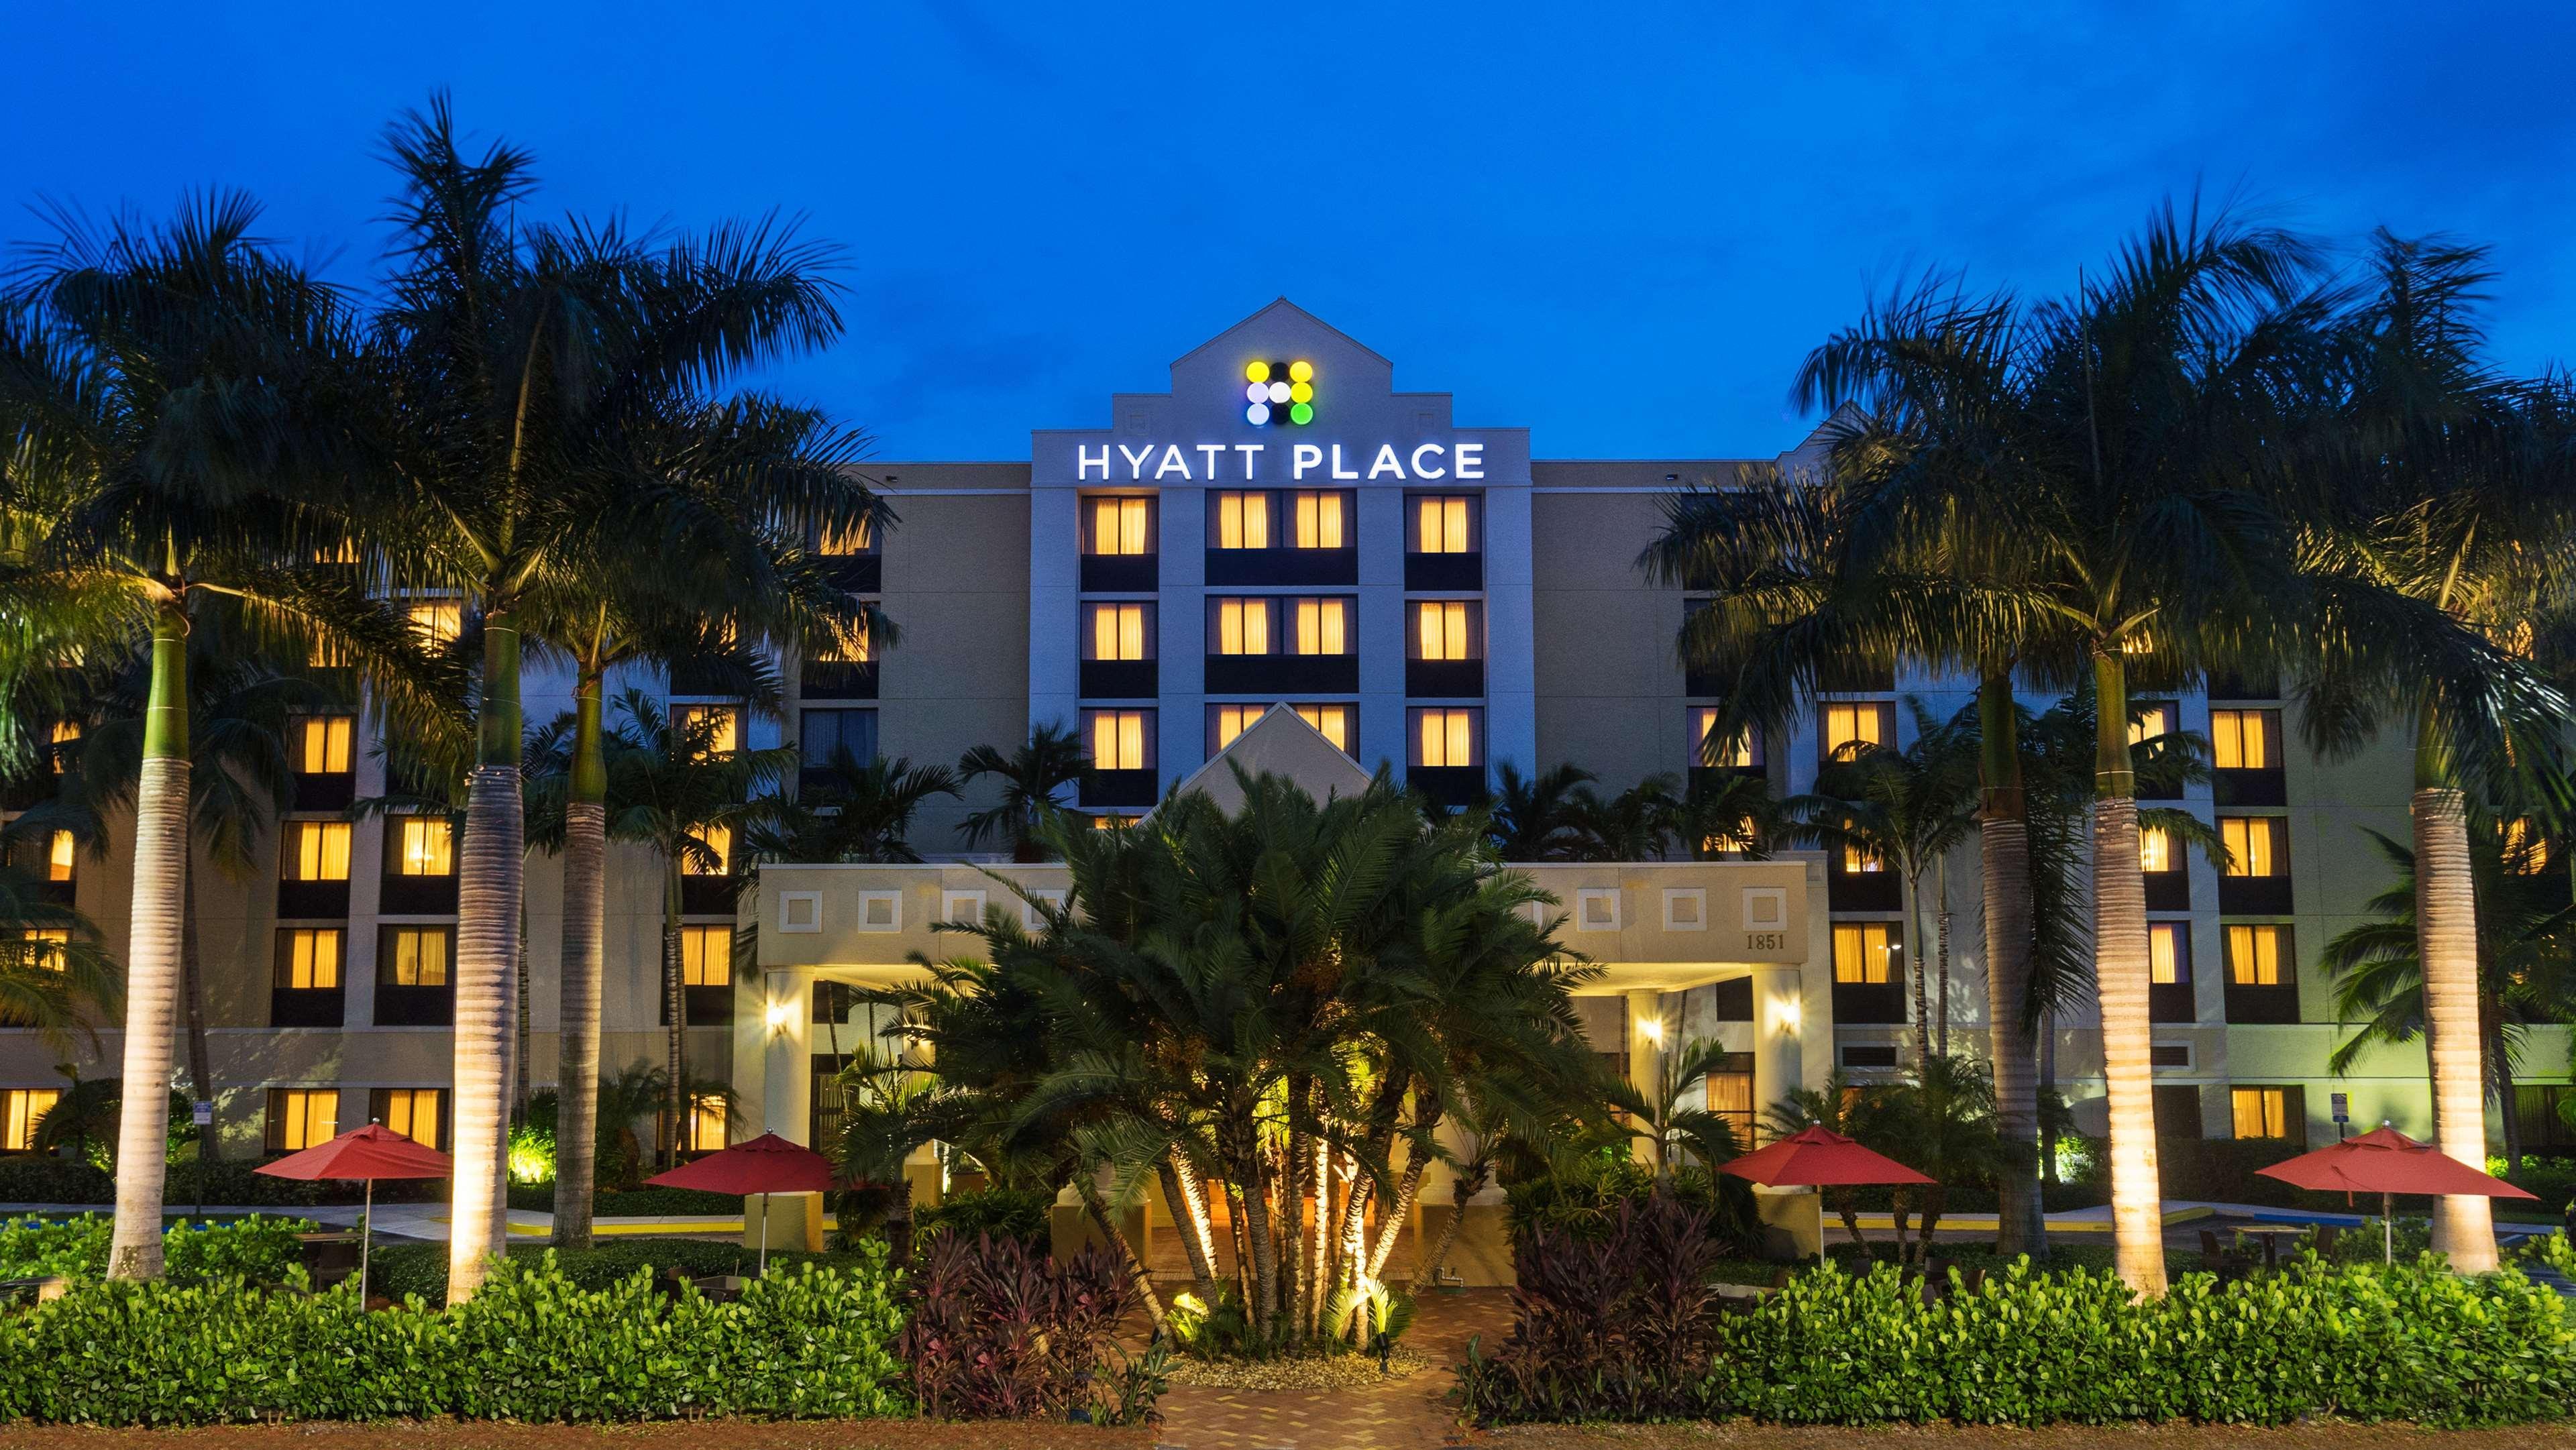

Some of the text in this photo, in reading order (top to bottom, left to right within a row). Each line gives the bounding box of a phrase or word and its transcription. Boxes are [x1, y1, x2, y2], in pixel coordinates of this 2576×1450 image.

[1078, 443, 1485, 480] HYATT PLACE
[1747, 934, 1784, 950] 1851
